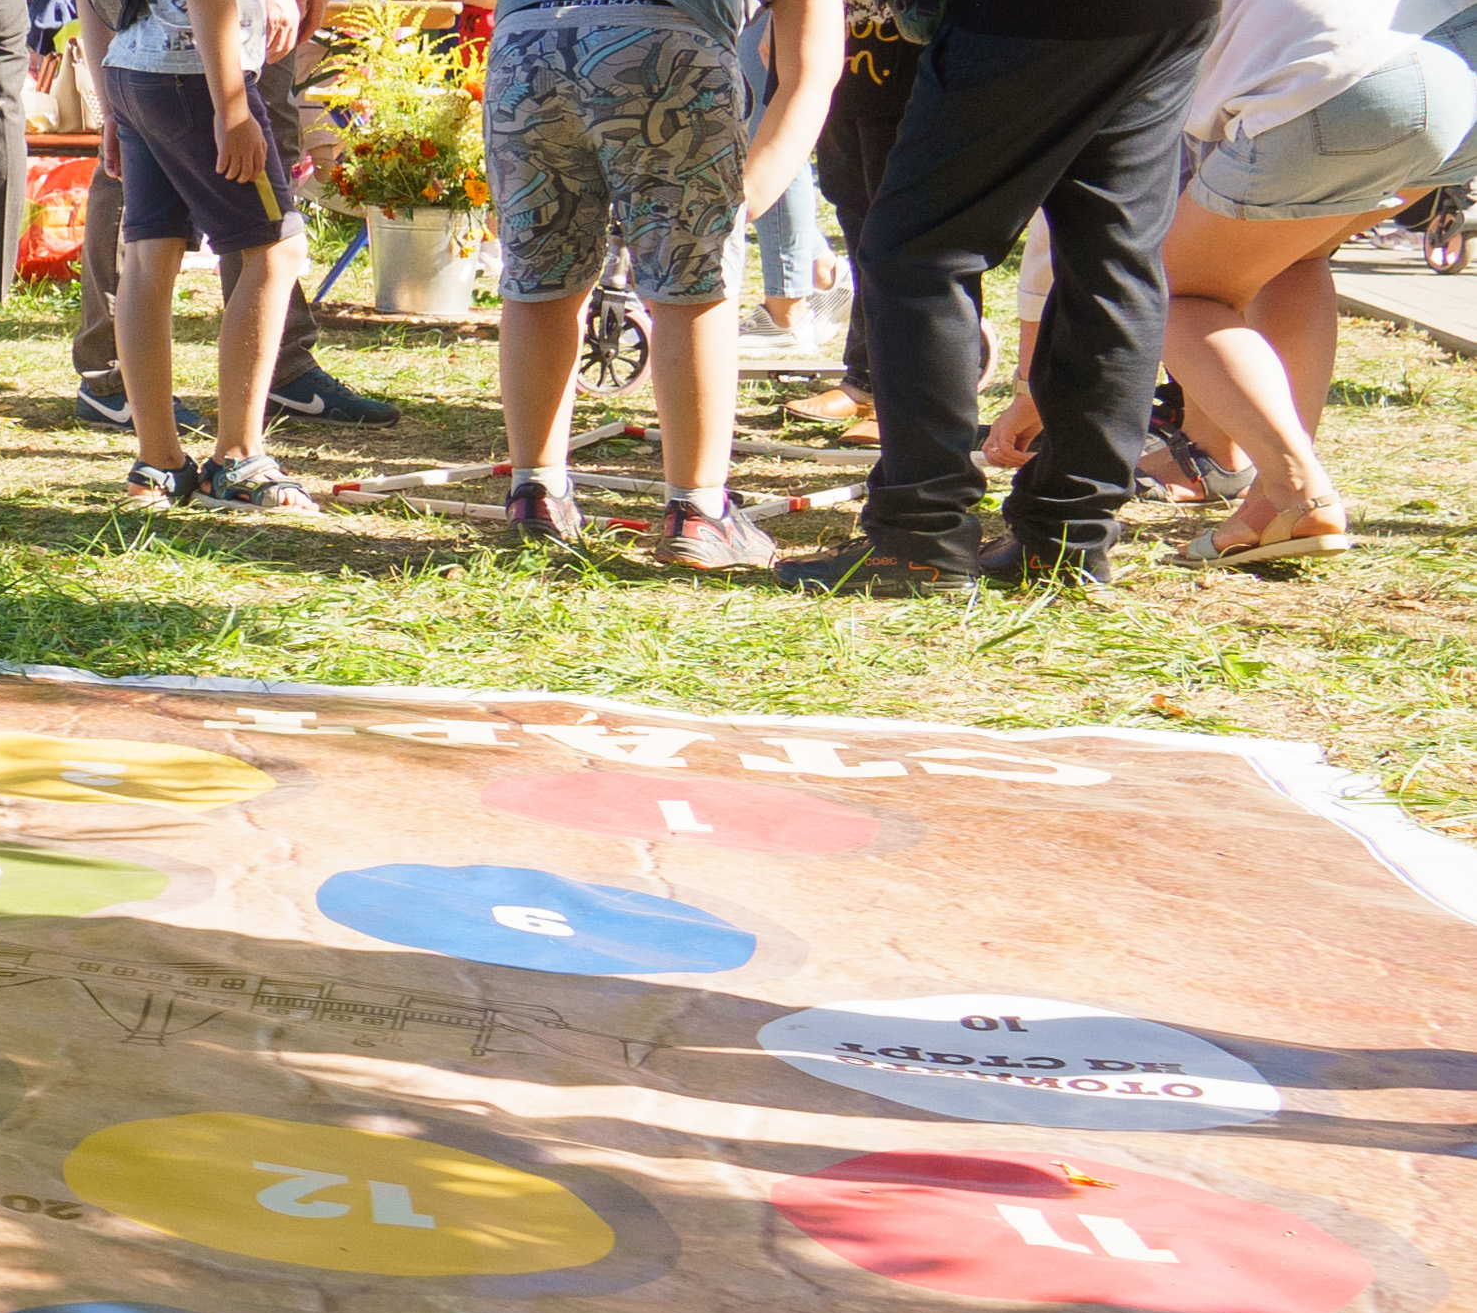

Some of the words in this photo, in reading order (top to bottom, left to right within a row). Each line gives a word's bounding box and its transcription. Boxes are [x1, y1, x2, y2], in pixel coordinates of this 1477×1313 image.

[203, 707, 1112, 786] СТАРТ
[659, 799, 714, 833] 1
[960, 1014, 1029, 1033] 10
[834, 1042, 1066, 1070] старт
[251, 1160, 438, 1230] 12
[994, 1202, 1181, 1264] 11
